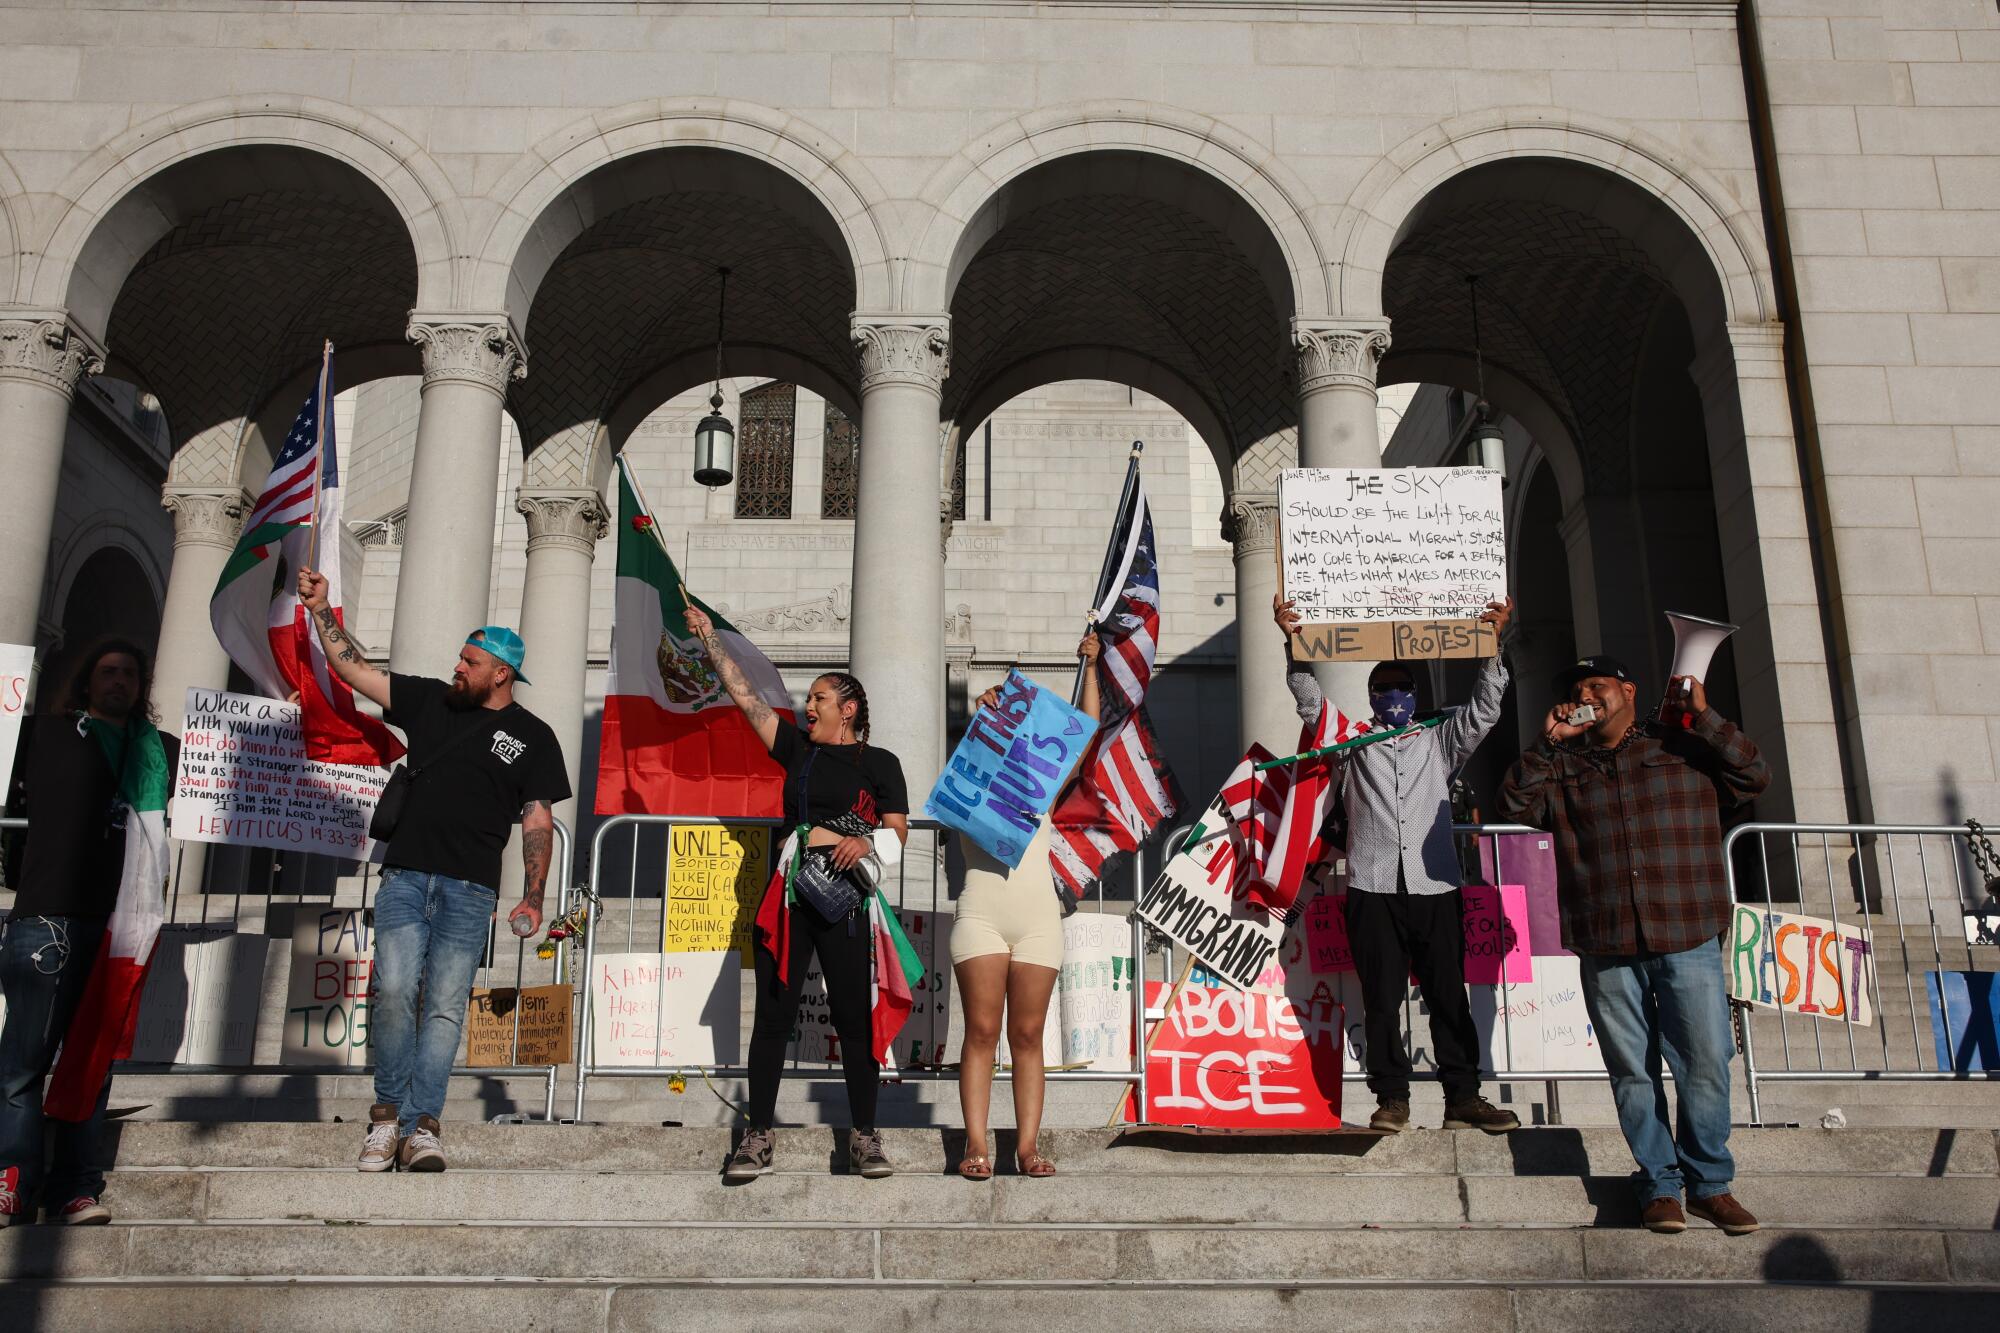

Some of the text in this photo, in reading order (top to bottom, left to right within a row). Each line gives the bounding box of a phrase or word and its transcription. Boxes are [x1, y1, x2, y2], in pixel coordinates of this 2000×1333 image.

[1392, 472, 1449, 503] SKY
[1287, 501, 1348, 521] SHOULD
[1352, 507, 1376, 520] BE
[1484, 510, 1501, 524] ALL
[1288, 554, 1316, 565] WHO
[1374, 553, 1430, 566] AMERICA
[1436, 551, 1454, 561] FOR
[1460, 553, 1467, 562] A
[1398, 568, 1439, 584] MAKES
[1444, 567, 1501, 582] AMERICA
[1342, 586, 1371, 604] NOT
[1448, 590, 1495, 607] RACISM
[1298, 622, 1492, 658] WE PROTEST
[229, 719, 254, 738] you
[185, 732, 213, 748] not
[217, 734, 236, 751] do
[240, 737, 266, 754] him
[270, 742, 286, 757] no
[498, 742, 522, 760] CITY
[503, 735, 527, 752] MUSIC
[181, 747, 216, 762] treat
[222, 750, 242, 765] the
[303, 762, 324, 775] who
[181, 776, 209, 788] shall
[216, 777, 241, 791] love
[246, 782, 270, 797] him
[276, 787, 289, 798] as
[341, 794, 356, 806] for
[358, 798, 373, 810] you
[183, 763, 206, 779] you
[212, 767, 227, 777] as
[231, 764, 253, 778] the
[258, 768, 292, 784] native
[297, 775, 331, 792] among
[363, 787, 381, 800] and
[935, 754, 992, 822] ICE
[985, 733, 1068, 834] NUTS
[260, 804, 281, 817] the
[319, 815, 340, 829] your
[263, 797, 282, 808] the
[289, 800, 312, 812] land
[317, 803, 327, 812] of
[199, 815, 304, 843] LEVITICUS
[674, 829, 761, 860] UNLESS
[673, 871, 705, 883] LIKE
[675, 858, 756, 873] SOMEONE
[672, 873, 760, 897] YOU CARES
[670, 901, 756, 919] AWFUL LOT
[668, 918, 724, 932] NOTHING
[1139, 872, 1277, 989] IMMIGRANTS
[690, 934, 710, 943] GET
[1735, 907, 1873, 1022] RESIST
[1146, 983, 1341, 1049] ABOLISH
[1148, 1050, 1306, 1115] ICE
